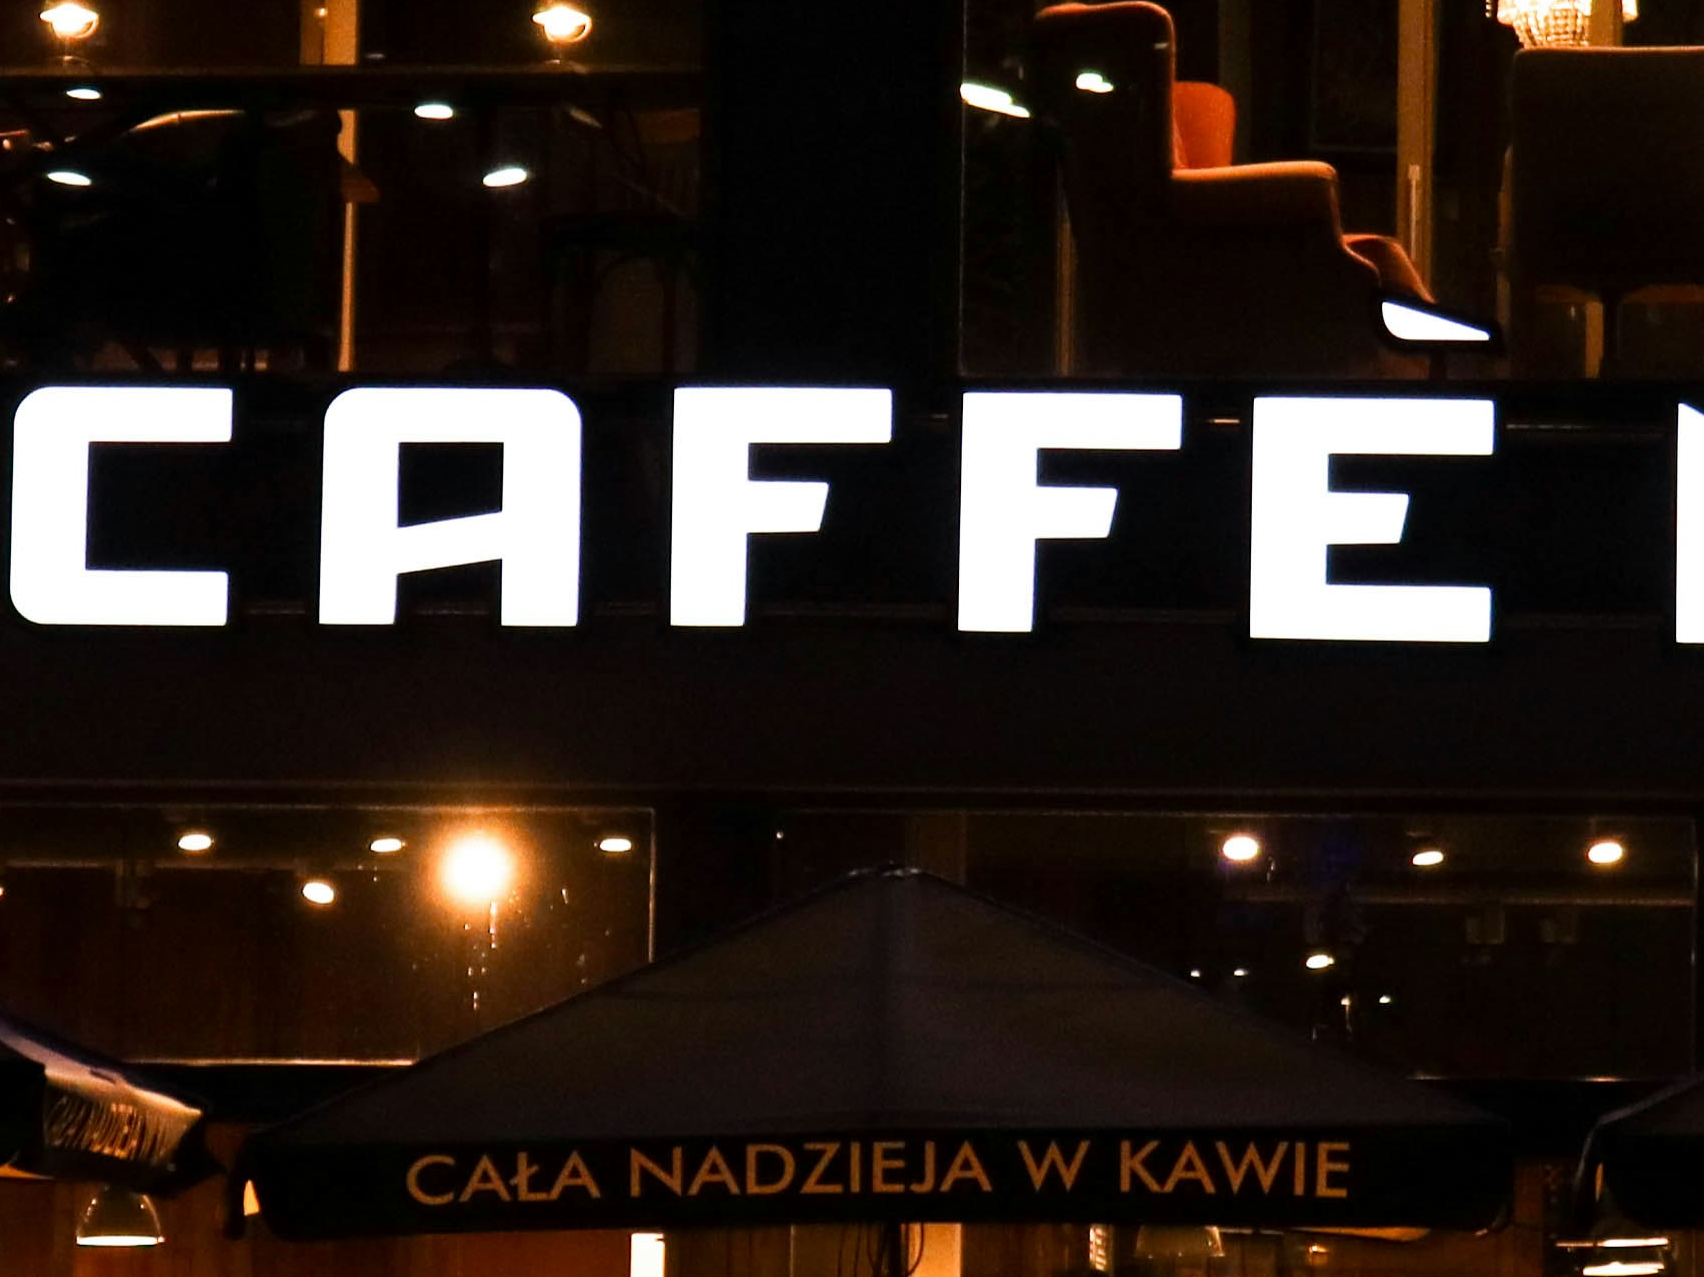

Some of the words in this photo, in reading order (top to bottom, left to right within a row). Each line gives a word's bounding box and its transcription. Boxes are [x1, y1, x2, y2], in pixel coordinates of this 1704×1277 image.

[8, 299, 1498, 646] CAFFÈ
[405, 1150, 603, 1206] CAŁA
[628, 1140, 994, 1199] NADZIEJA
[1017, 1139, 1091, 1193] W
[1118, 1140, 1351, 1200] KAWIE
